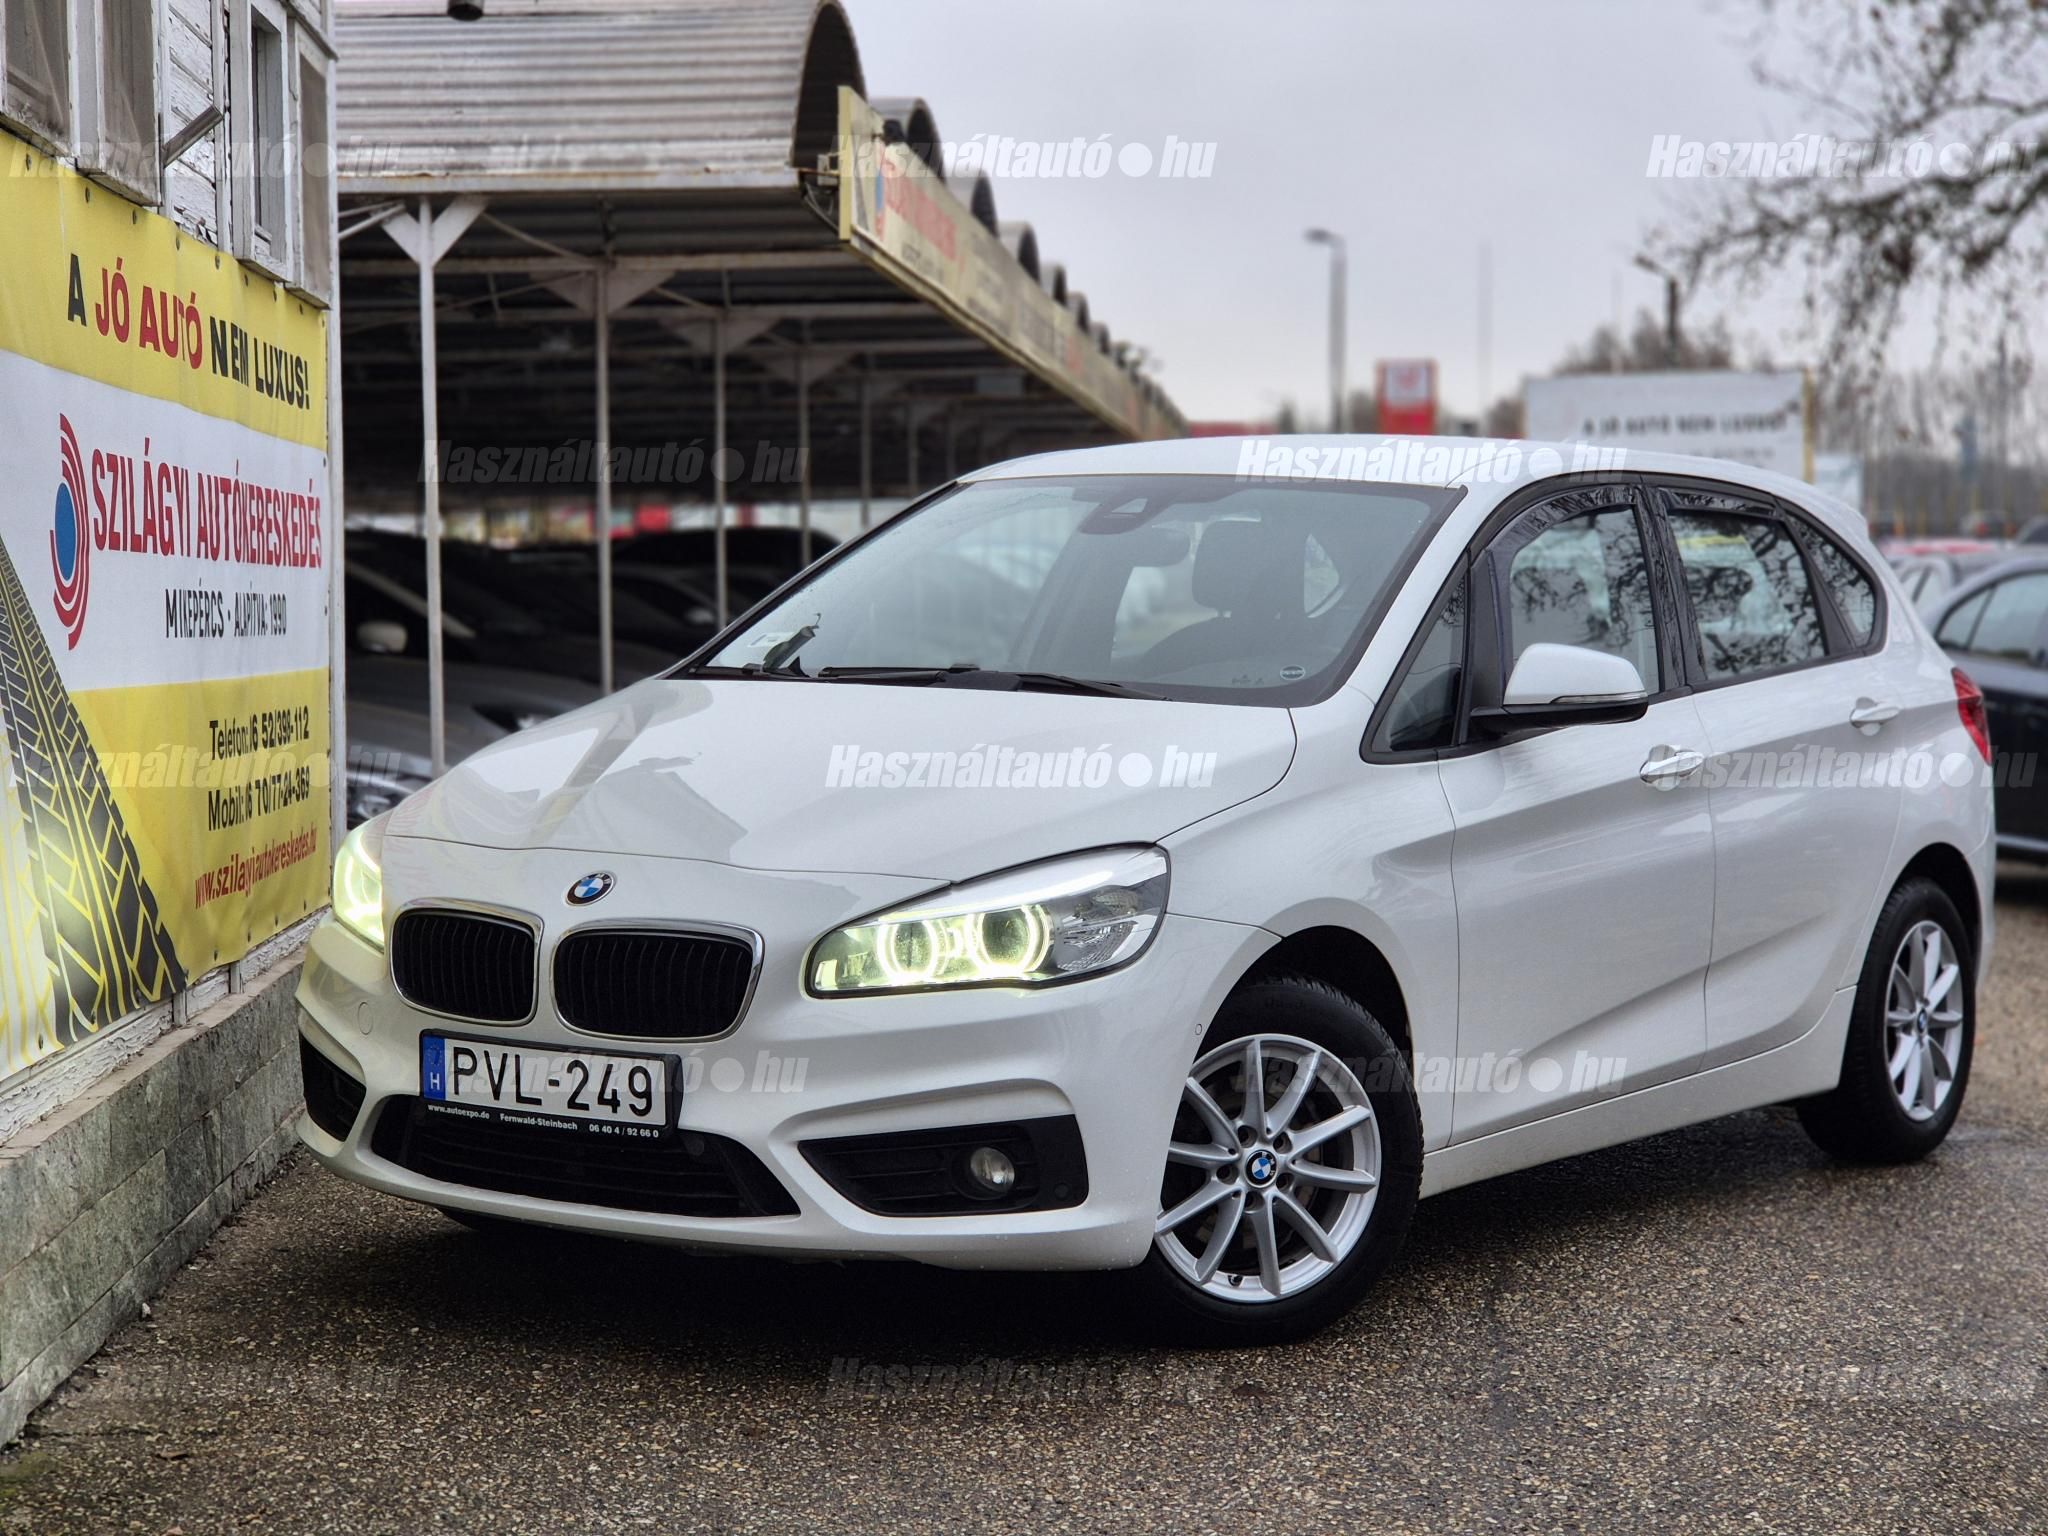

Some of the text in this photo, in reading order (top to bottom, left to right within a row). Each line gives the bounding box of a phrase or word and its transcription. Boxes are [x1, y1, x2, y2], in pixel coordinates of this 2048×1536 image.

[68, 253, 310, 410] A JÓ AUTÓ NEM LUXUS!
[92, 437, 322, 569] SZILÁGYI AUTÓKERESKEDÉS
[165, 579, 224, 638] MIKEPÉRCS
[270, 594, 287, 636] 1990
[430, 1072, 440, 1090] H
[453, 1047, 652, 1117] PVL-249
[427, 1103, 490, 1120] www.autoexpo.de
[500, 1113, 578, 1131] Fernwald-Steinbach
[589, 1124, 599, 1133] 06
